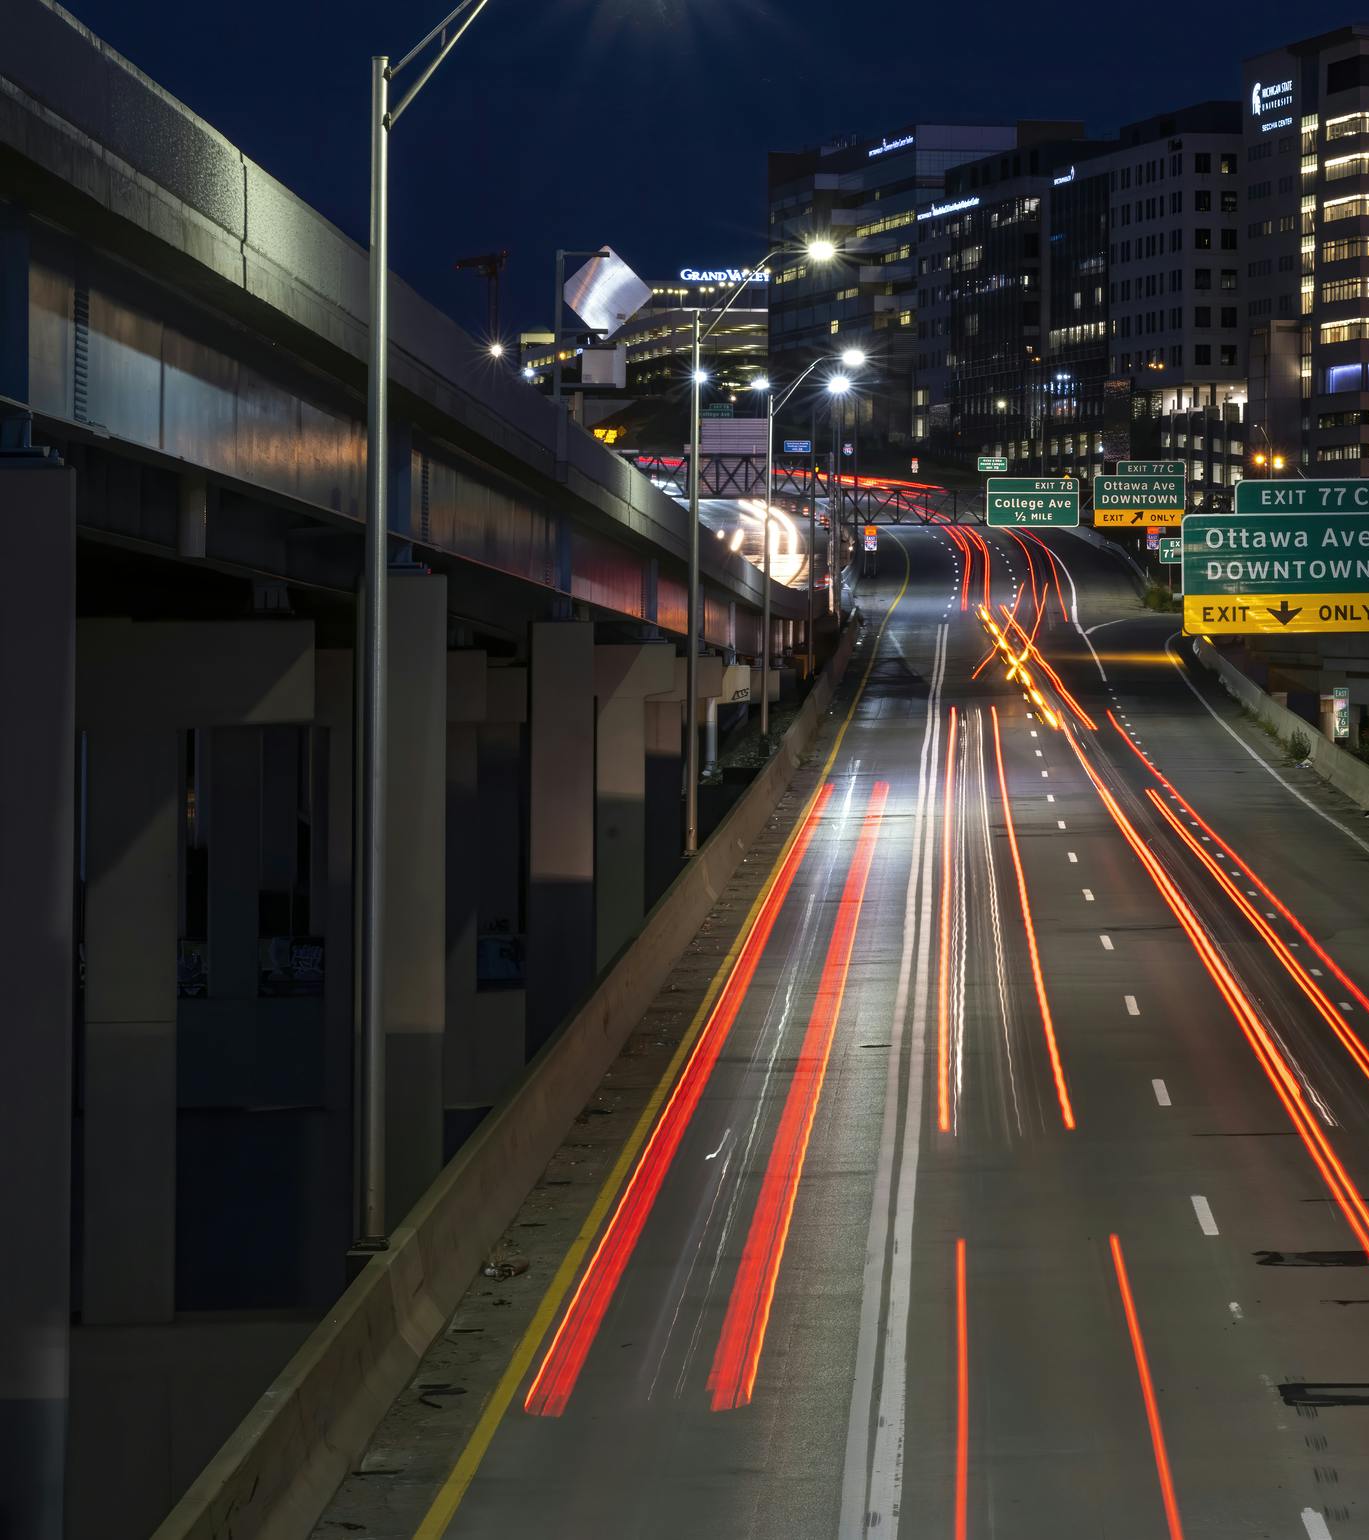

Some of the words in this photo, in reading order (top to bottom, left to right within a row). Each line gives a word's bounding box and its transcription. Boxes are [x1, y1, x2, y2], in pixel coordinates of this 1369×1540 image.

[1262, 95, 1292, 111] UNIVERSITY
[680, 268, 727, 281] GRAND
[1127, 465, 1148, 473] EXIT
[1035, 482, 1055, 490] EXIT
[1059, 481, 1073, 490] 78
[1103, 481, 1148, 490] Ottawa
[1153, 481, 1176, 490] Ave
[1101, 494, 1178, 504] DOWNTOWN
[1261, 489, 1307, 505] EXIT
[994, 498, 1044, 510] College
[1048, 498, 1072, 508] Ave
[1031, 512, 1053, 521] MILE
[1103, 514, 1124, 522] EXIT
[1150, 514, 1176, 522] ONLY
[1205, 528, 1309, 548] Ottawa
[1202, 606, 1250, 622] EXIT
